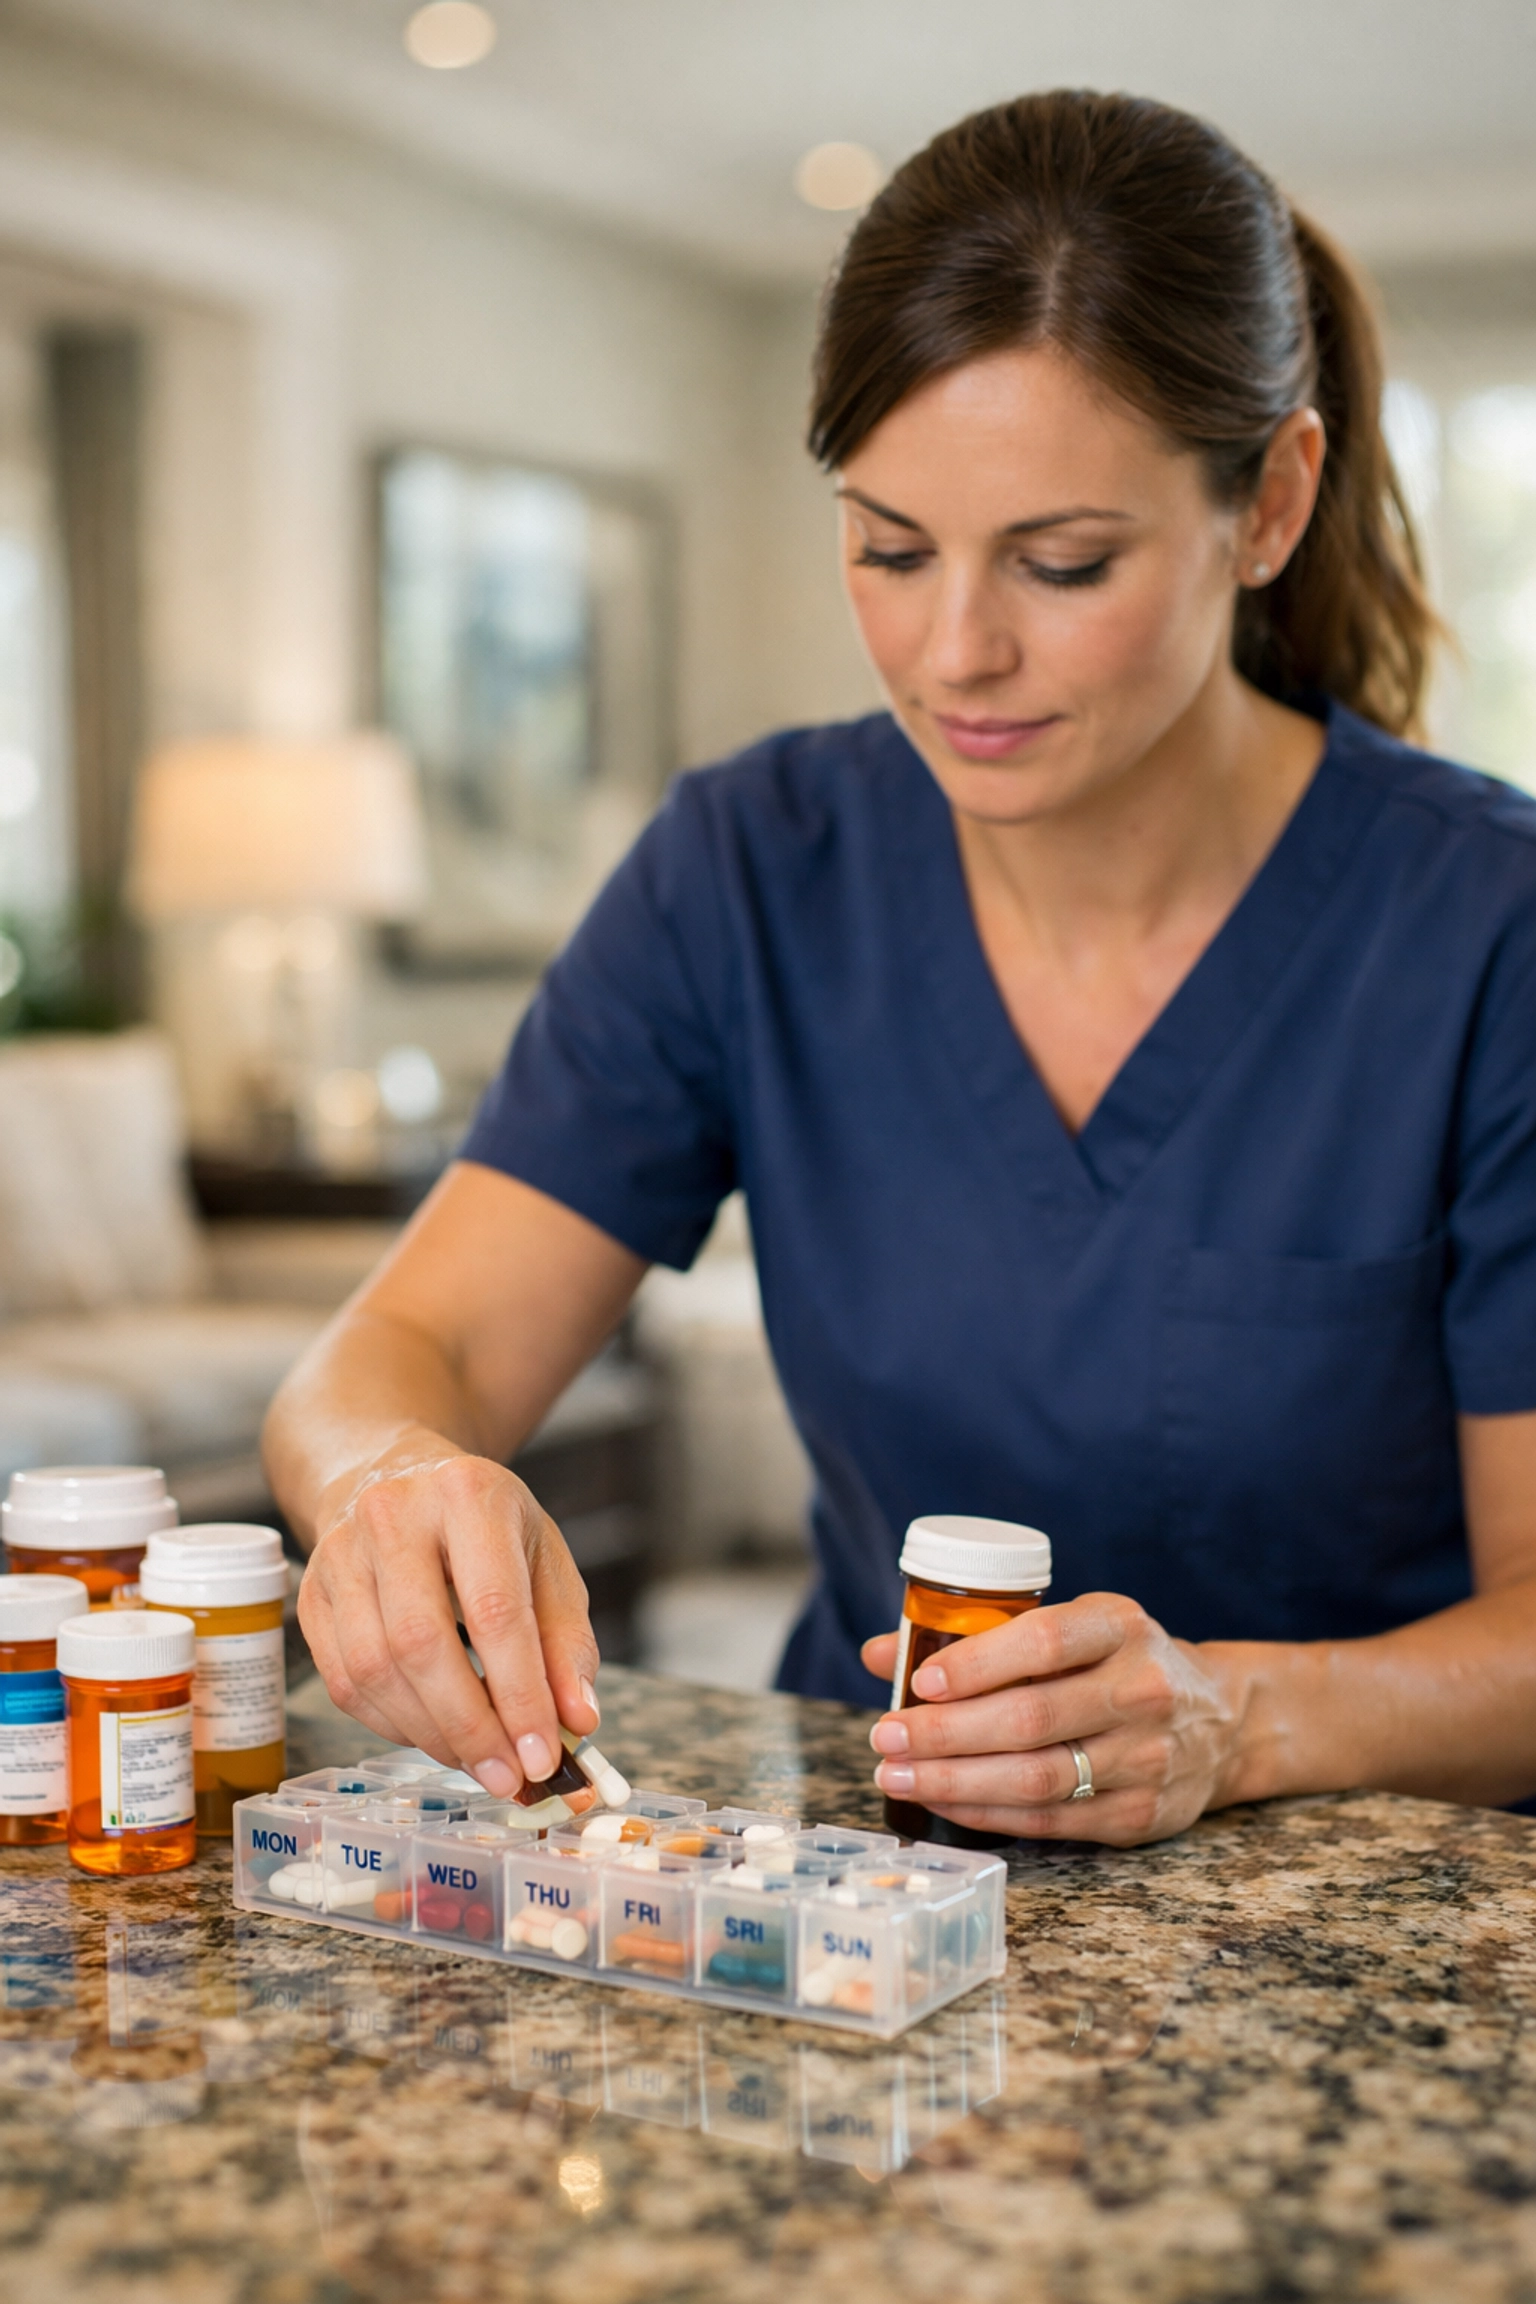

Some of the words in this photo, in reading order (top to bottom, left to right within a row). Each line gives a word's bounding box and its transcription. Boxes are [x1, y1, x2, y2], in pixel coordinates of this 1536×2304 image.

[252, 1829, 297, 1856] MON
[341, 1844, 382, 1871] TUE
[428, 1863, 477, 1890] WED
[525, 1881, 570, 1909] THU
[625, 1901, 661, 1925] FRI
[725, 1916, 764, 1943] SRI
[823, 1932, 872, 1960] SUN
